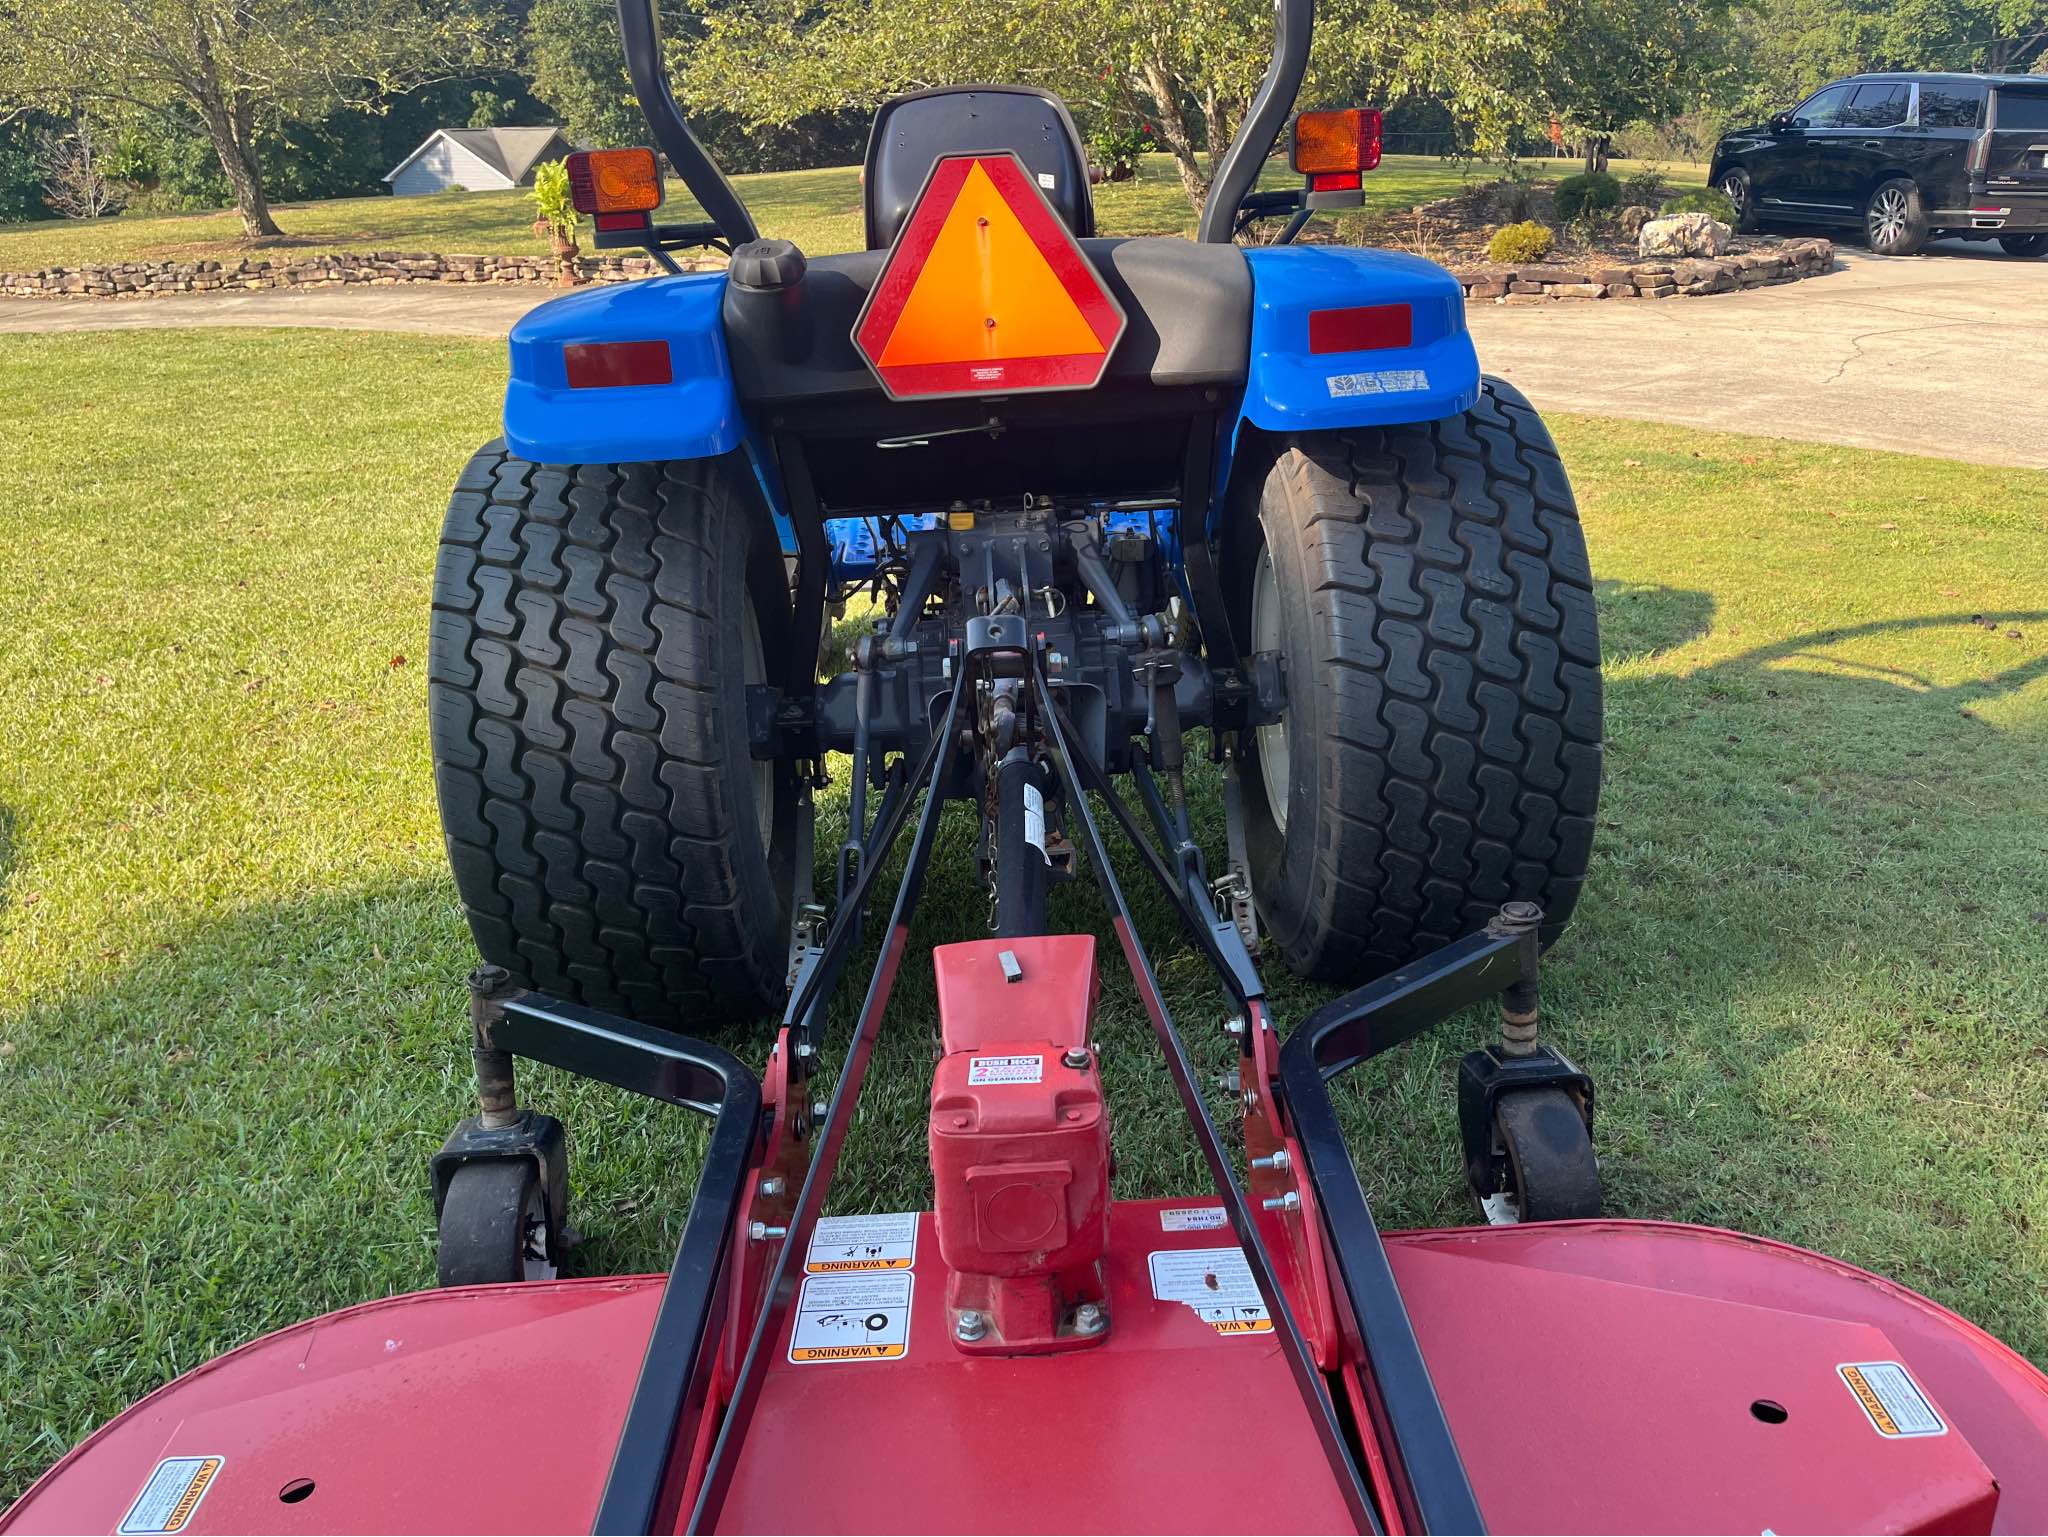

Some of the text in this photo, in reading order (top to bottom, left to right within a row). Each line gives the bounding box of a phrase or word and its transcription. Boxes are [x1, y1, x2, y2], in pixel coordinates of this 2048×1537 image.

[978, 1059, 1009, 1067] BUSH
[975, 1068, 989, 1077] 2
[822, 1260, 881, 1270] WARNING
[808, 1347, 872, 1358] WARNING
[1847, 1370, 1886, 1419] WARNING
[170, 1473, 209, 1526] WARNING
